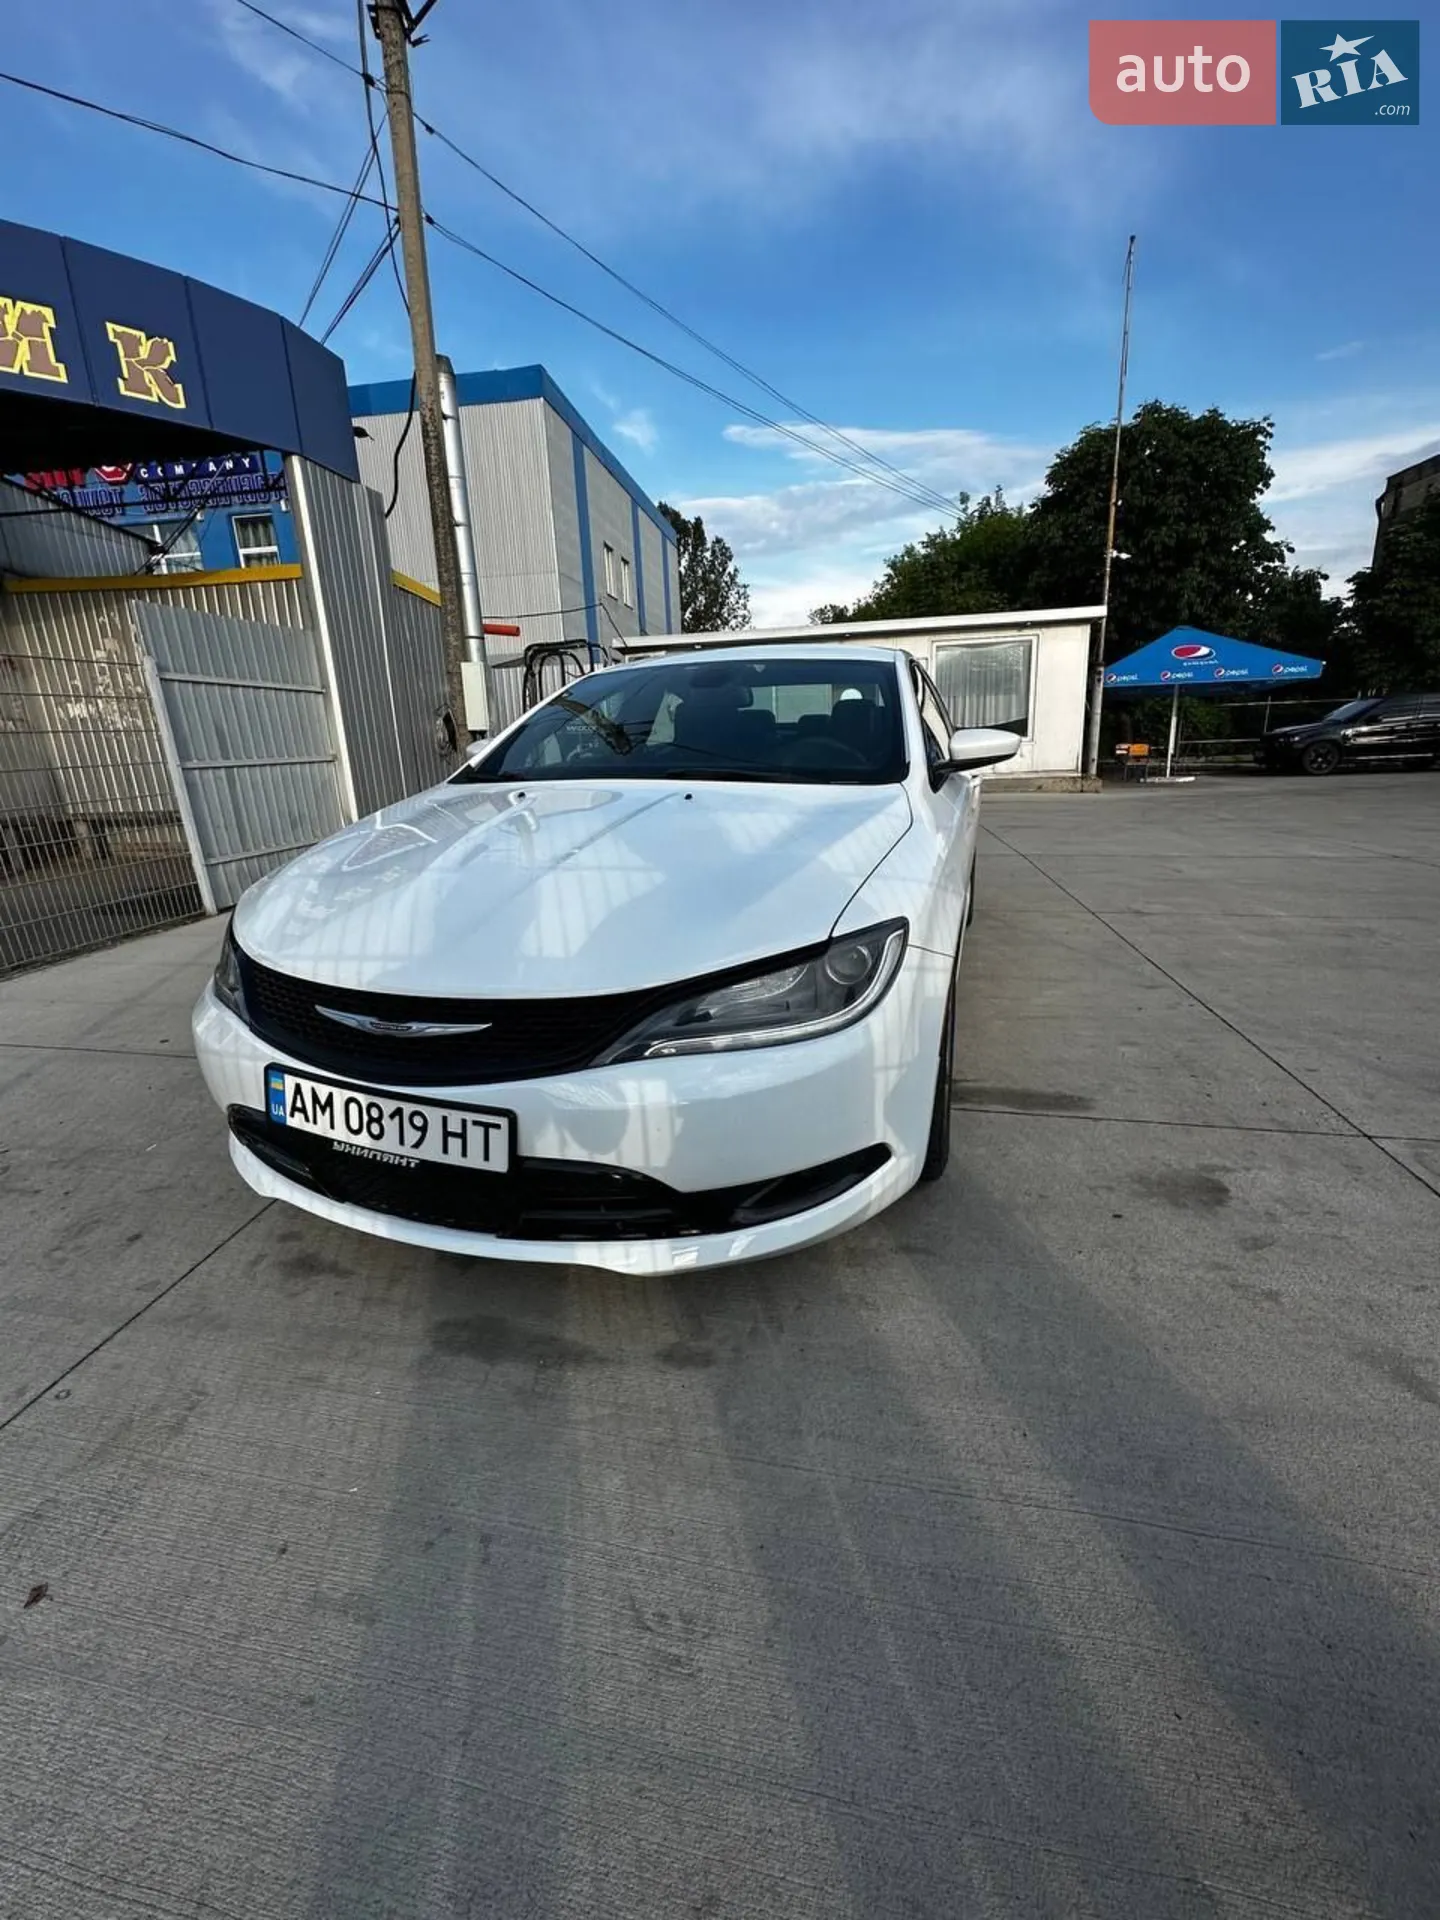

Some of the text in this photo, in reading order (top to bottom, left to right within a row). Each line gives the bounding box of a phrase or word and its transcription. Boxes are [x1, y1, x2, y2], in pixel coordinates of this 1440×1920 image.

[271, 1104, 286, 1117] UA
[289, 1082, 502, 1162] AM 0819 HT
